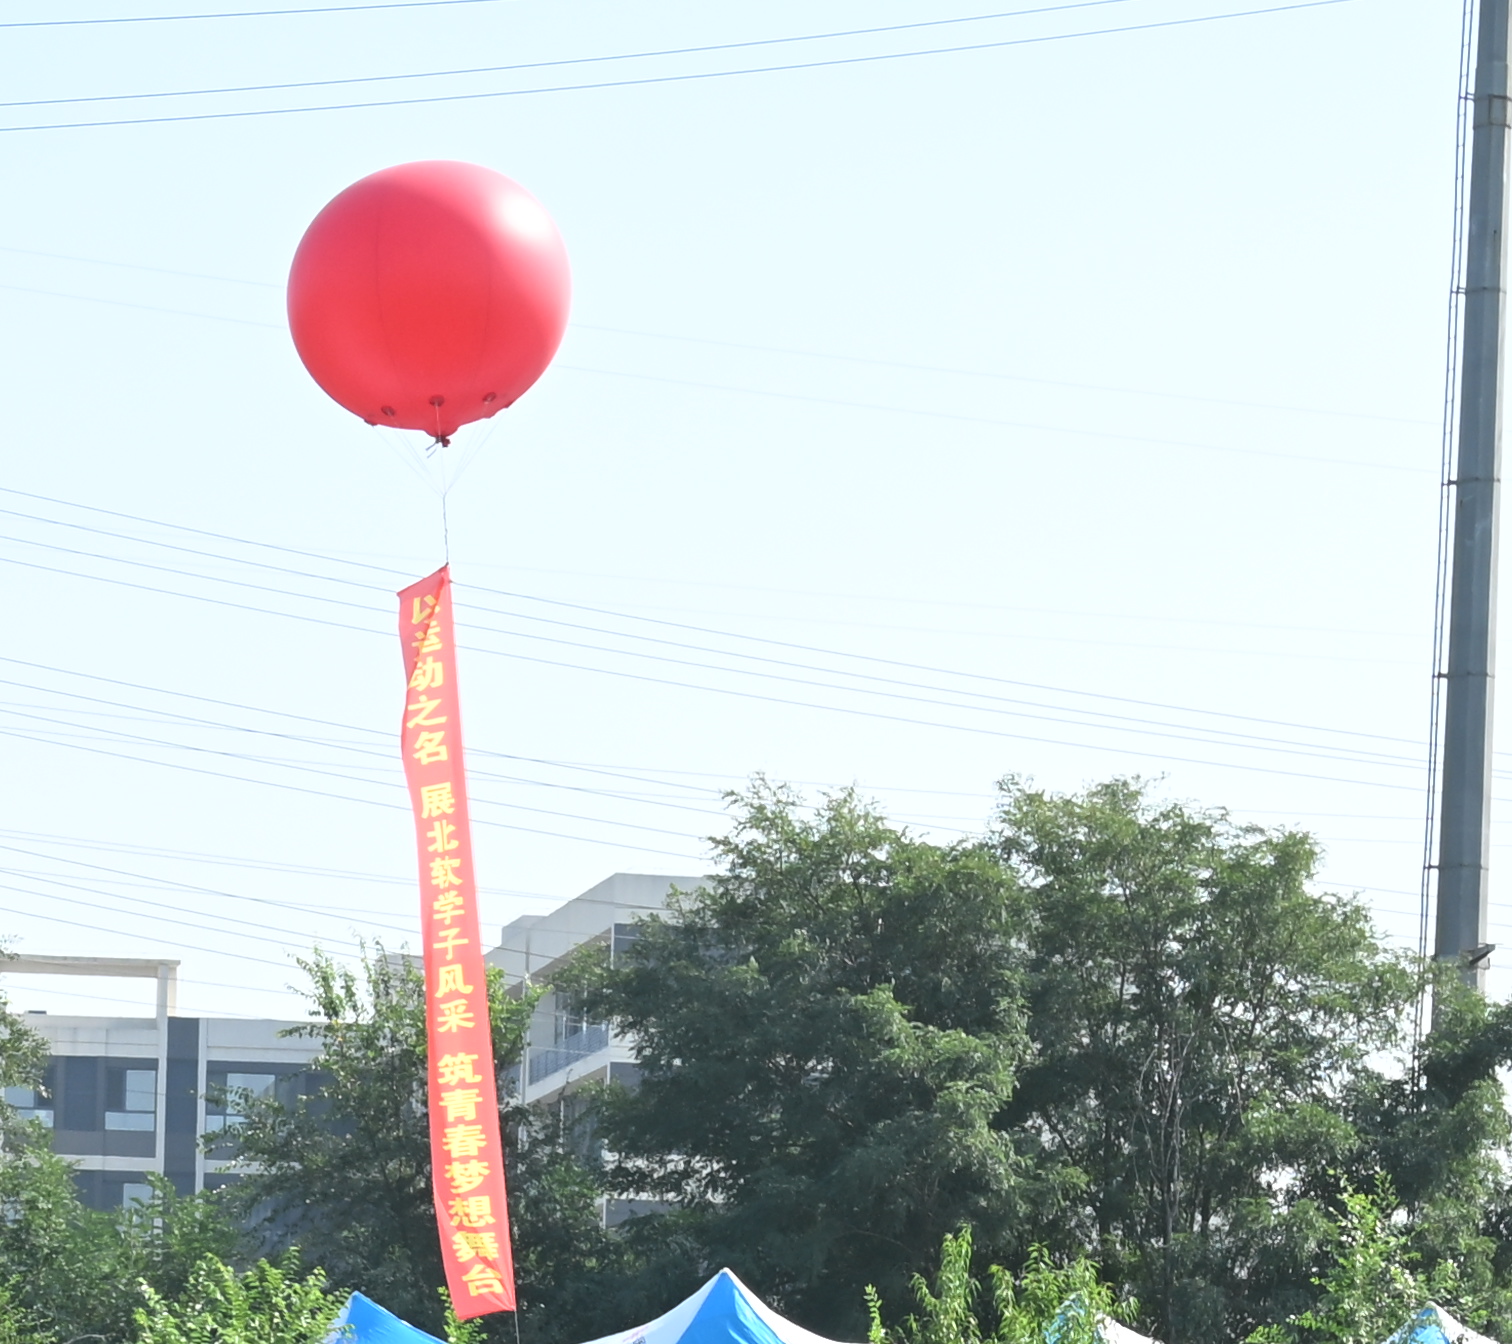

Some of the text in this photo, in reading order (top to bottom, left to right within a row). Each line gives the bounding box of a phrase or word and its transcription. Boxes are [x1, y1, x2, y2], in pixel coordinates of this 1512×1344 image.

[420, 781, 476, 1033] 展北软学子风采
[436, 1051, 505, 1297] 筑青春梦想舞台
